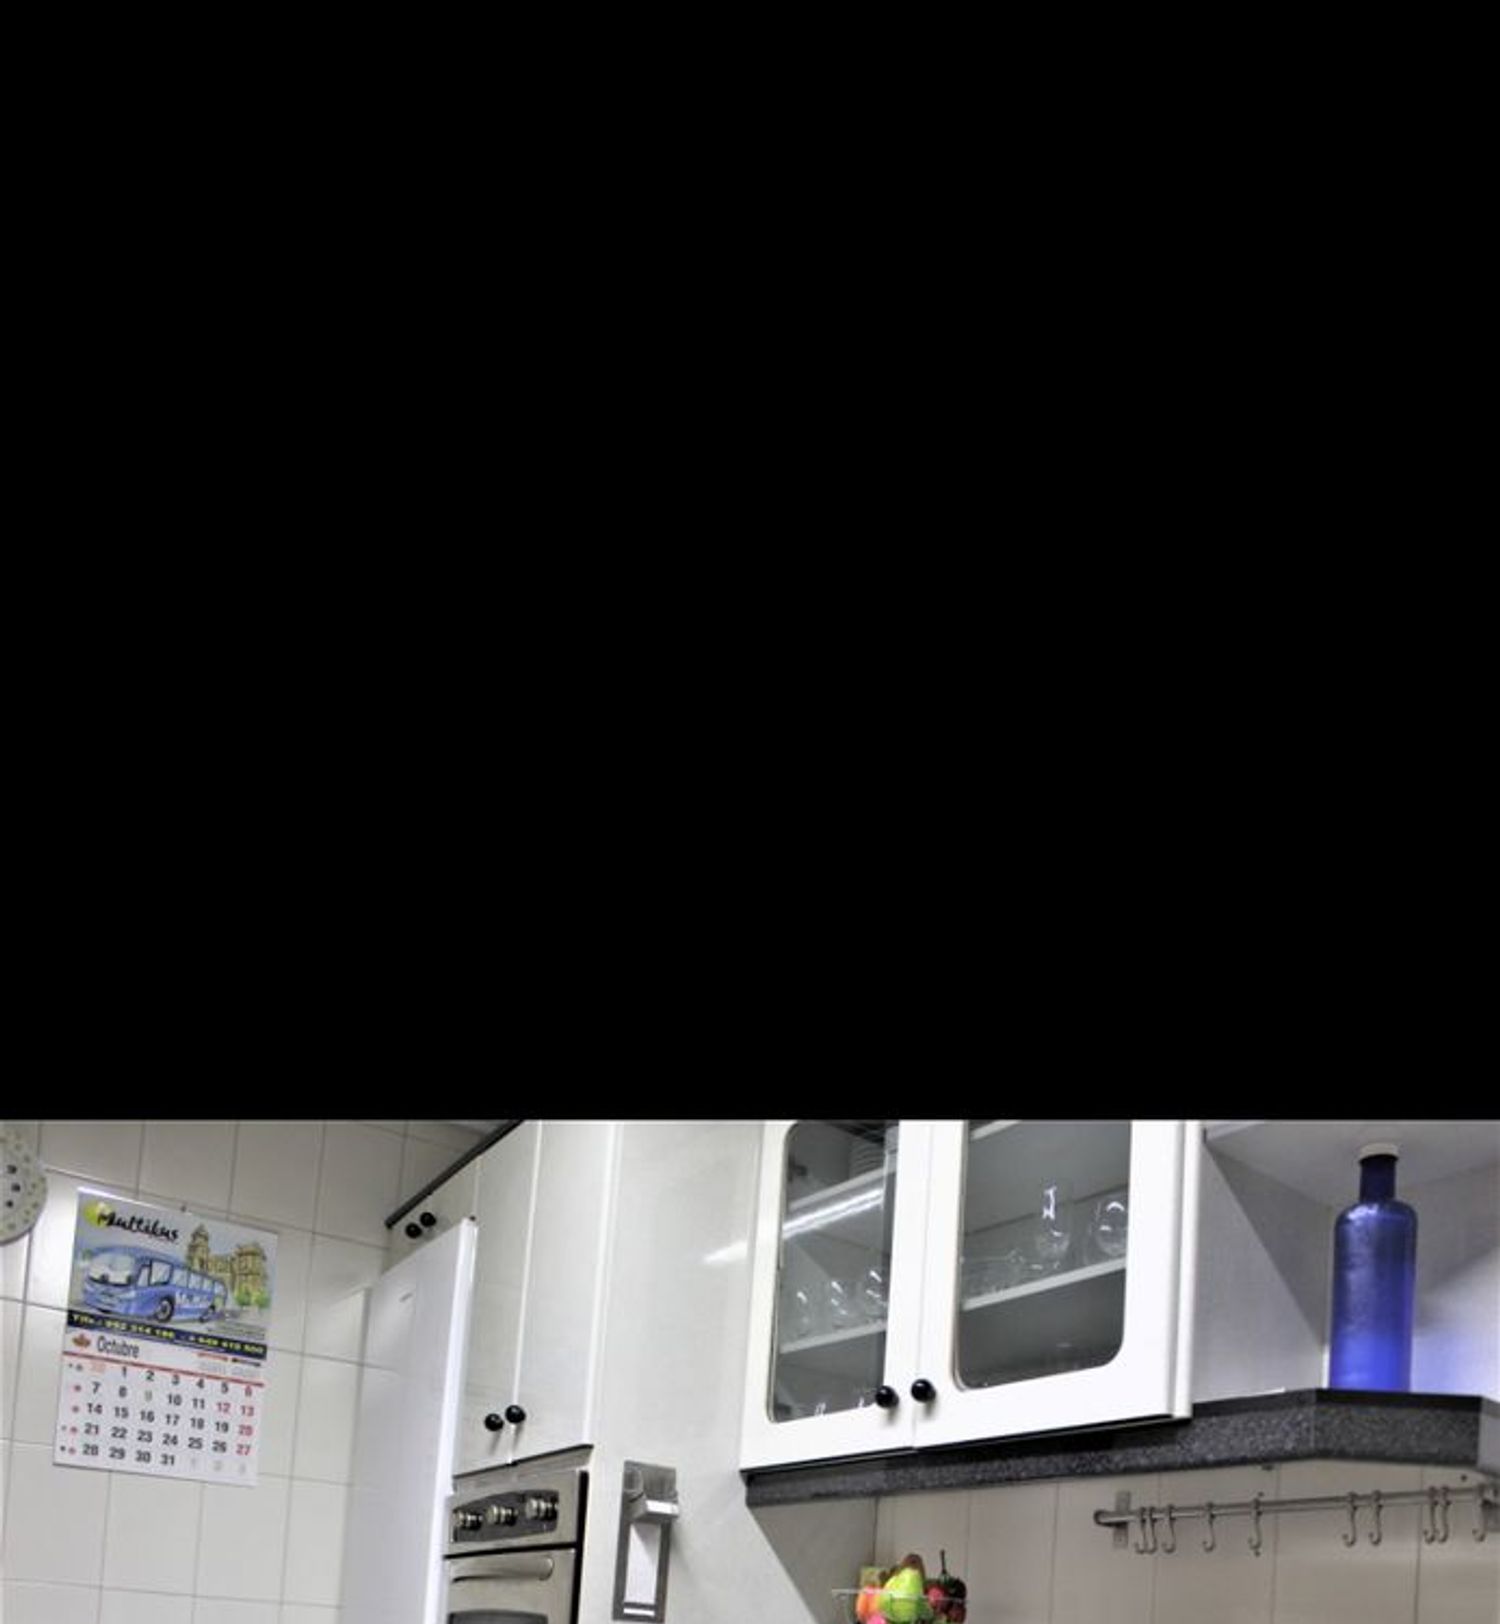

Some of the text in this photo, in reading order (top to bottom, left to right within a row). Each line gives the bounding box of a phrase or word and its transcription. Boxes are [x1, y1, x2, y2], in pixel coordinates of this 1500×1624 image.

[97, 1212, 179, 1241] Multibus
[98, 1335, 140, 1359] Octubre
[122, 1365, 128, 1378] 1
[146, 1370, 155, 1382] 2
[172, 1374, 180, 1386] 3
[196, 1378, 205, 1390] 4
[221, 1382, 229, 1394] 5
[92, 1381, 101, 1395] 7
[119, 1385, 128, 1399] 8
[167, 1393, 182, 1407] 10
[192, 1397, 205, 1410] 11
[217, 1402, 231, 1414] 12
[241, 1405, 255, 1418] 13
[87, 1402, 254, 1437] 14 15 16 17 18 19 20
[84, 1422, 252, 1457] 21 22 23 24 25 26 27
[82, 1443, 99, 1457] 28
[109, 1446, 126, 1460] 29
[135, 1449, 152, 1463] 30
[160, 1453, 175, 1466] 31
